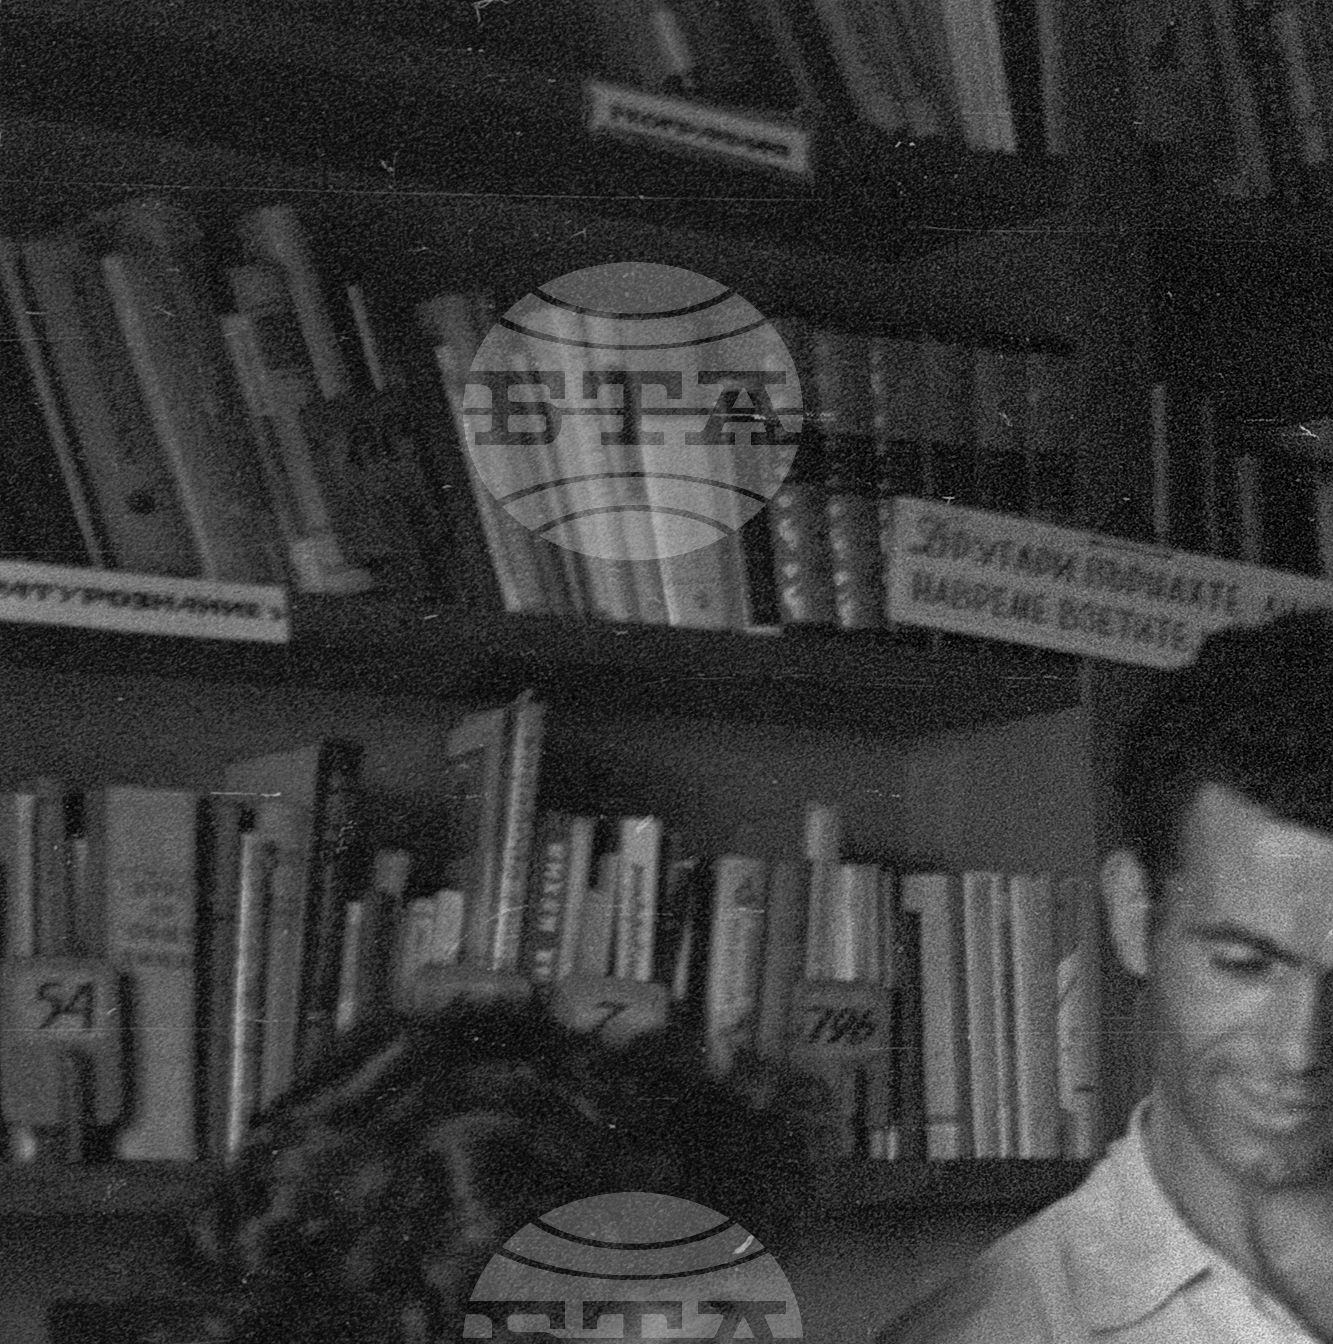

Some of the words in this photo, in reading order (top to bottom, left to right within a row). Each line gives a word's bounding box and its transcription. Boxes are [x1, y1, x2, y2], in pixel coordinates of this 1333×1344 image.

[0, 578, 261, 621] АТУРОЗНАНИЕ
[909, 568, 1047, 626] НАВРЕМЕ
[805, 1005, 877, 1046] 796
